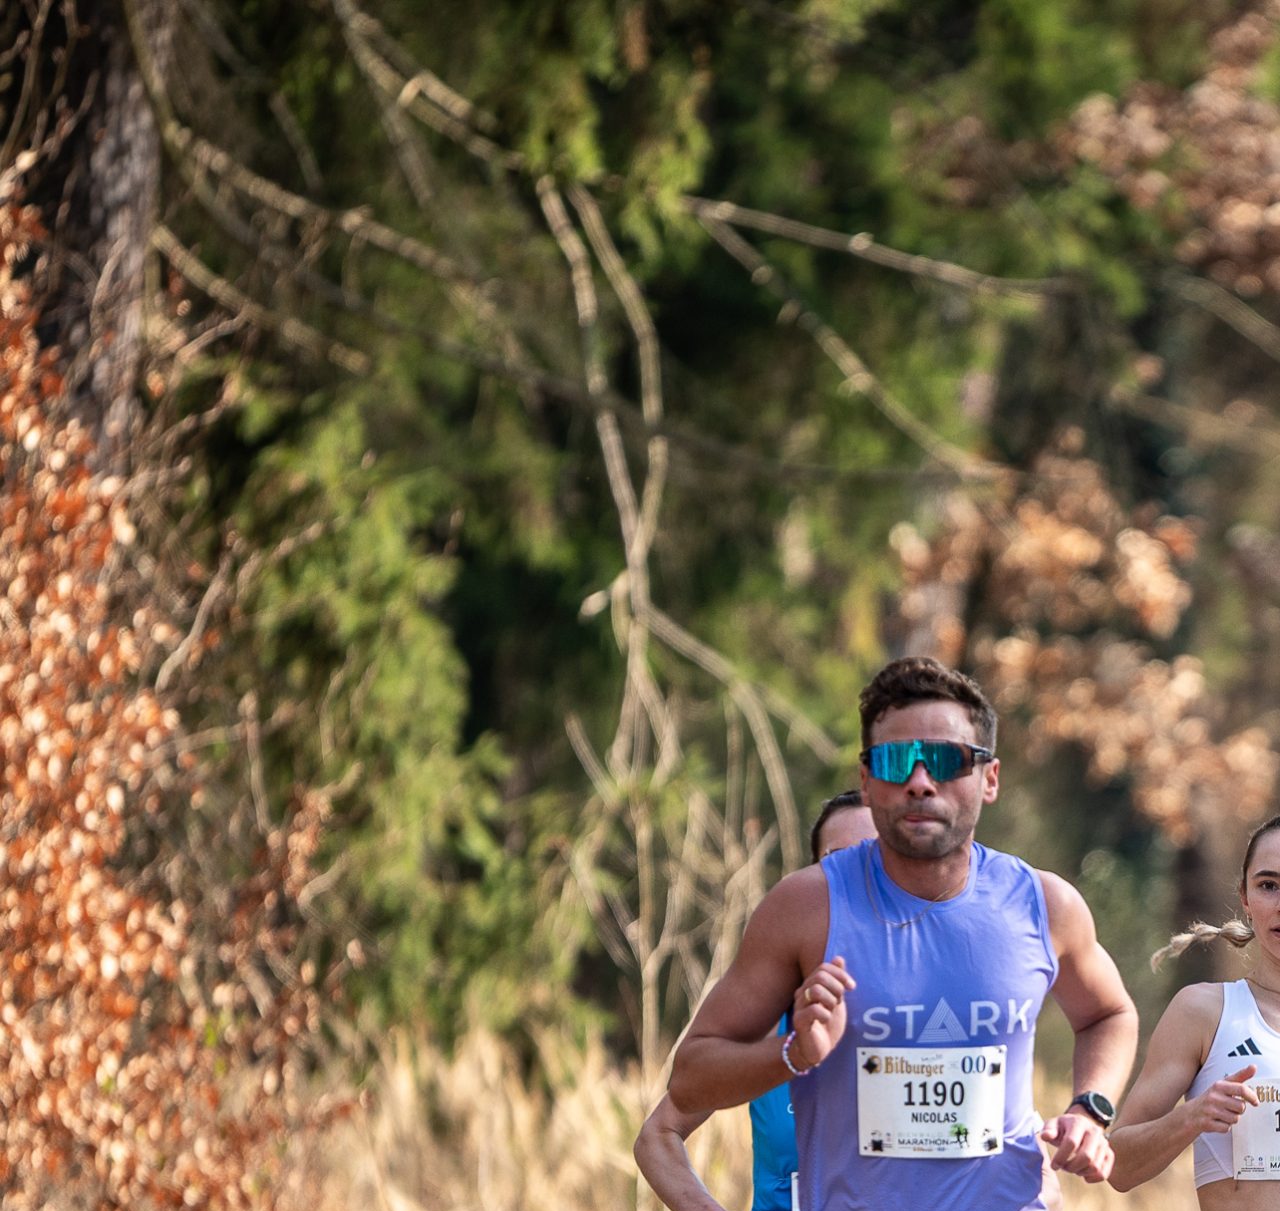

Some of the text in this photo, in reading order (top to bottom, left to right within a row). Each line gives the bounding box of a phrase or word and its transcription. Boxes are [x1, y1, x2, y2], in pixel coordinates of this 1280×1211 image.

[862, 997, 1034, 1043] STARK
[884, 1056, 945, 1077] Bitburger
[961, 1055, 987, 1075] 0.0
[903, 1081, 965, 1107] 1190
[911, 1112, 958, 1124] NICOLAS
[898, 1138, 950, 1146] MARATHON
